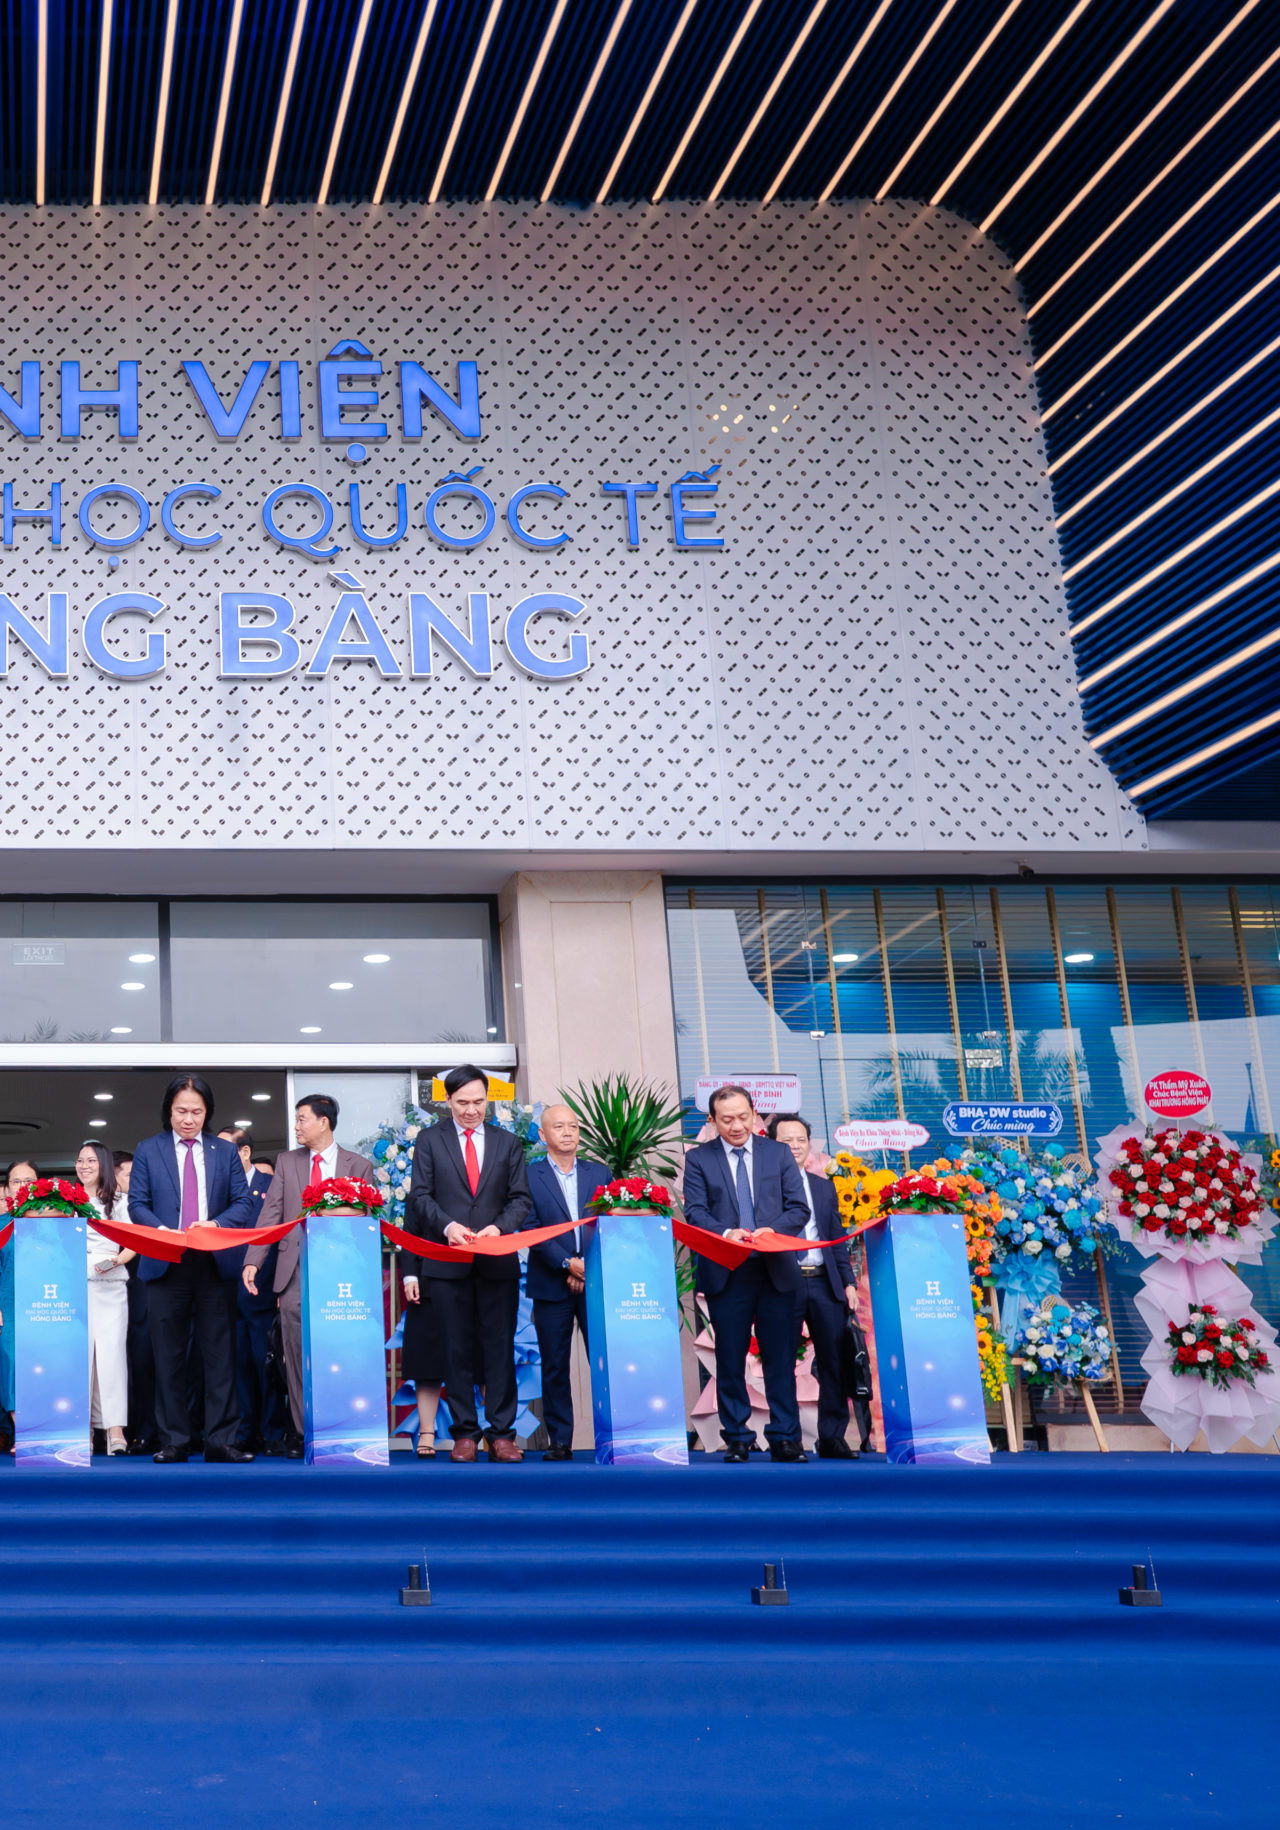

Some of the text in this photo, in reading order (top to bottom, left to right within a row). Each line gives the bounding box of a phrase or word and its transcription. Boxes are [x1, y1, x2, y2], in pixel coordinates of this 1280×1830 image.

[180, 339, 482, 467] VIỆN
[2, 482, 223, 571] HỌC
[261, 465, 570, 563] QUỐC
[600, 463, 725, 552] TẾ
[219, 570, 591, 682] BÀNG
[23, 946, 54, 955] EXIT
[1149, 1081, 1159, 1090] PK
[1178, 1080, 1188, 1090] Mỹ
[1153, 1089, 1170, 1098] Chúc
[1149, 1098, 1161, 1107] KHAI
[989, 1107, 1011, 1118] DW
[1012, 1107, 1047, 1118] studio
[971, 1118, 1035, 1134] Chúc mừng
[43, 1284, 58, 1299] H
[338, 1283, 352, 1298] H
[632, 1283, 647, 1297] H
[925, 1281, 941, 1296] H
